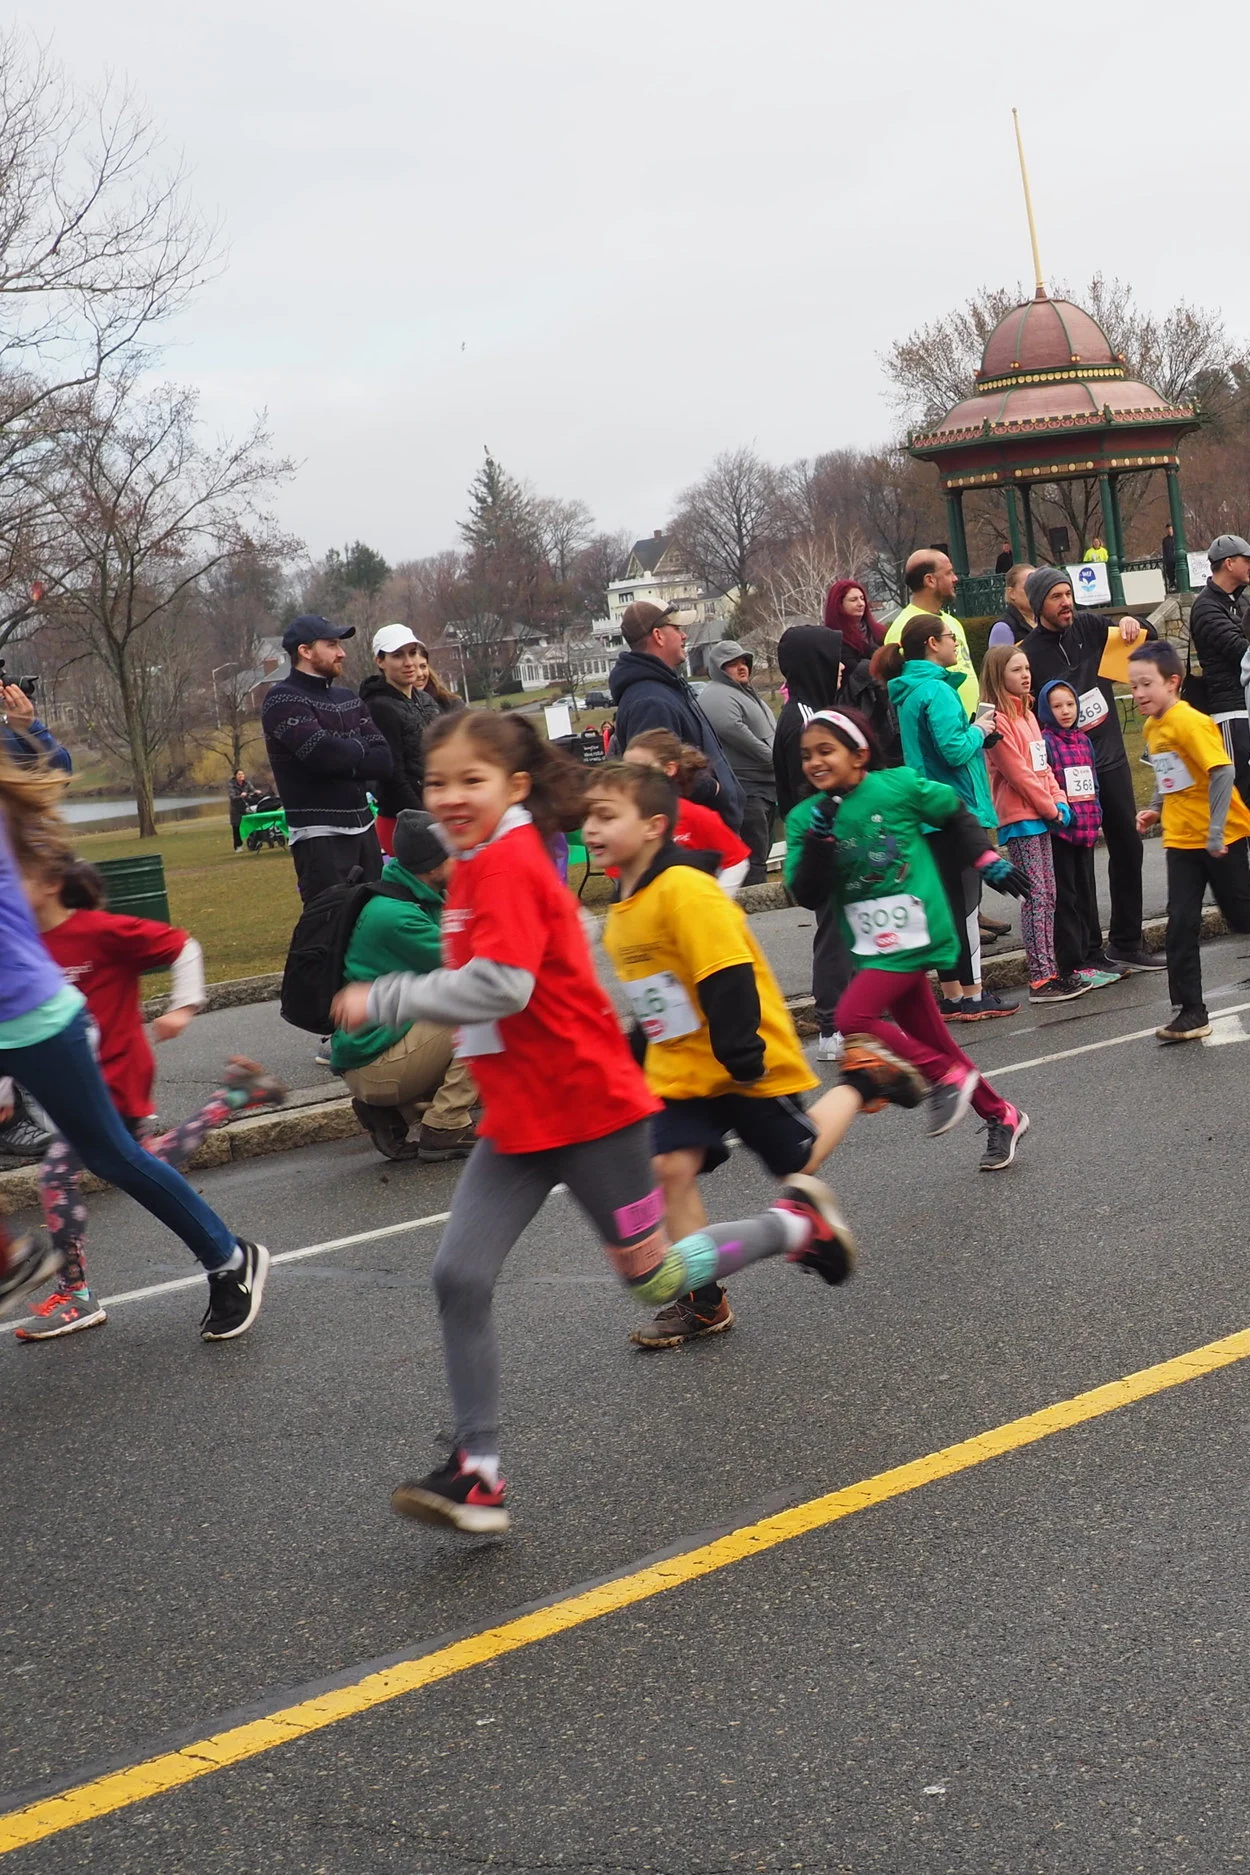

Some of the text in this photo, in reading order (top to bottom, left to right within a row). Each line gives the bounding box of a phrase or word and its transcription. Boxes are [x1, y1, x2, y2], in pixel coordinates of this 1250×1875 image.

[1079, 702, 1102, 723] 369
[1074, 779, 1093, 792] 368
[858, 906, 908, 934] 309
